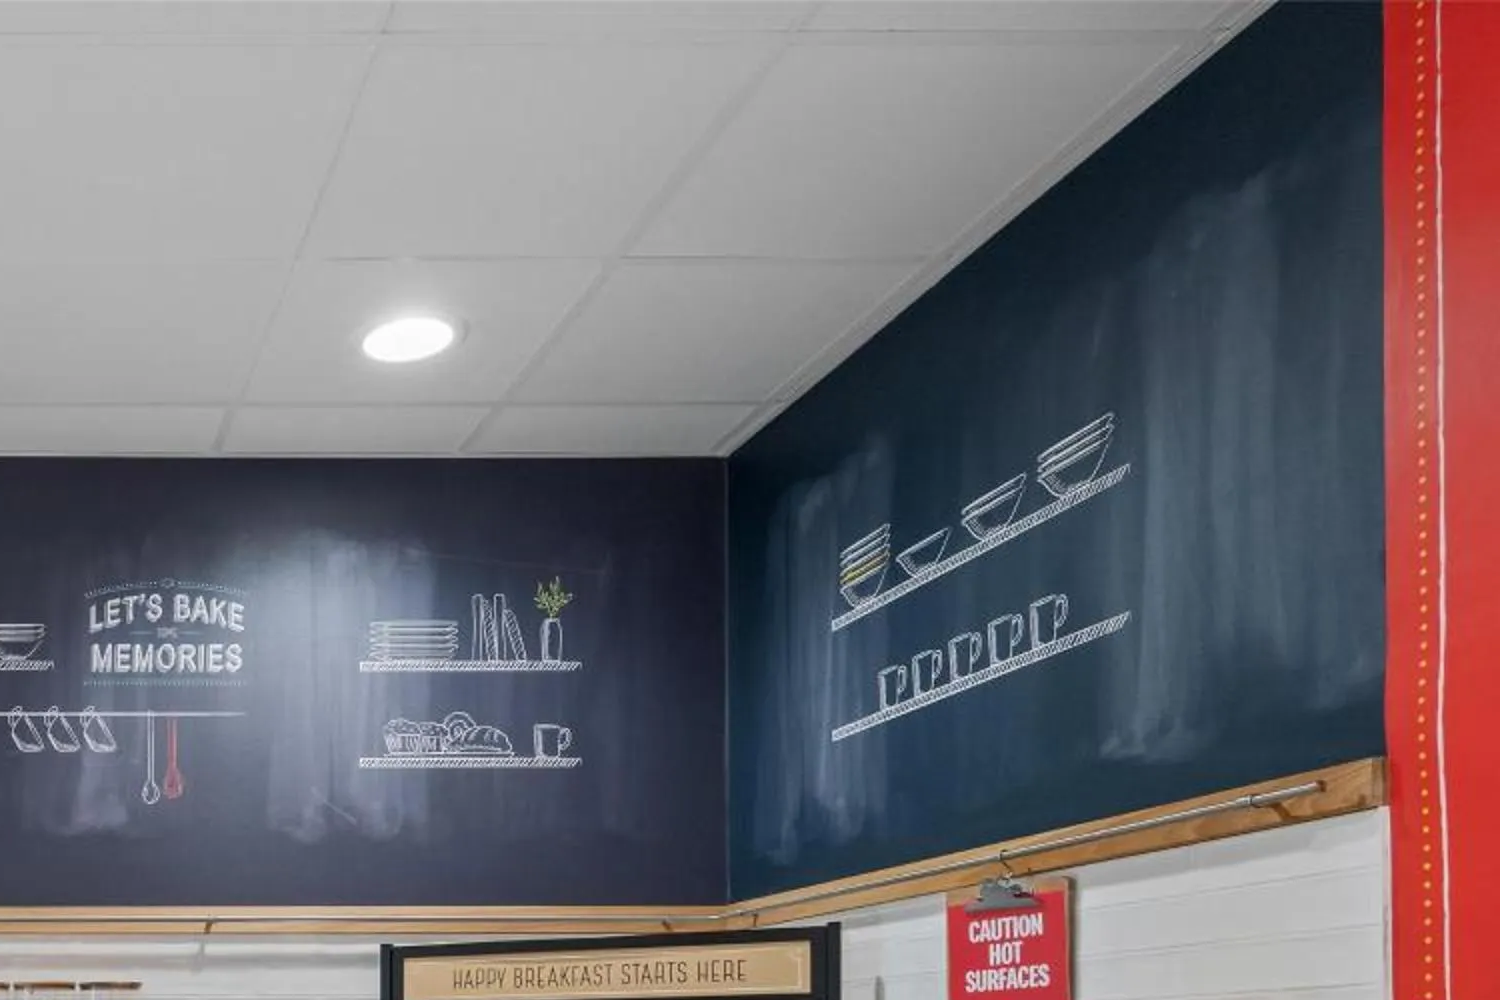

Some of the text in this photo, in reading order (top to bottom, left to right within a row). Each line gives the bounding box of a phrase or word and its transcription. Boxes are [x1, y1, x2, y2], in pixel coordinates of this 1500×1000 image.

[88, 593, 245, 634] LET'S BAKE
[91, 643, 243, 673] MEMORIES
[968, 912, 1043, 943] CAUTION
[989, 941, 1023, 966] HOT
[453, 959, 747, 990] HAPPY BREAKFAST STARTS HERE
[965, 963, 1050, 993] SURFACES
